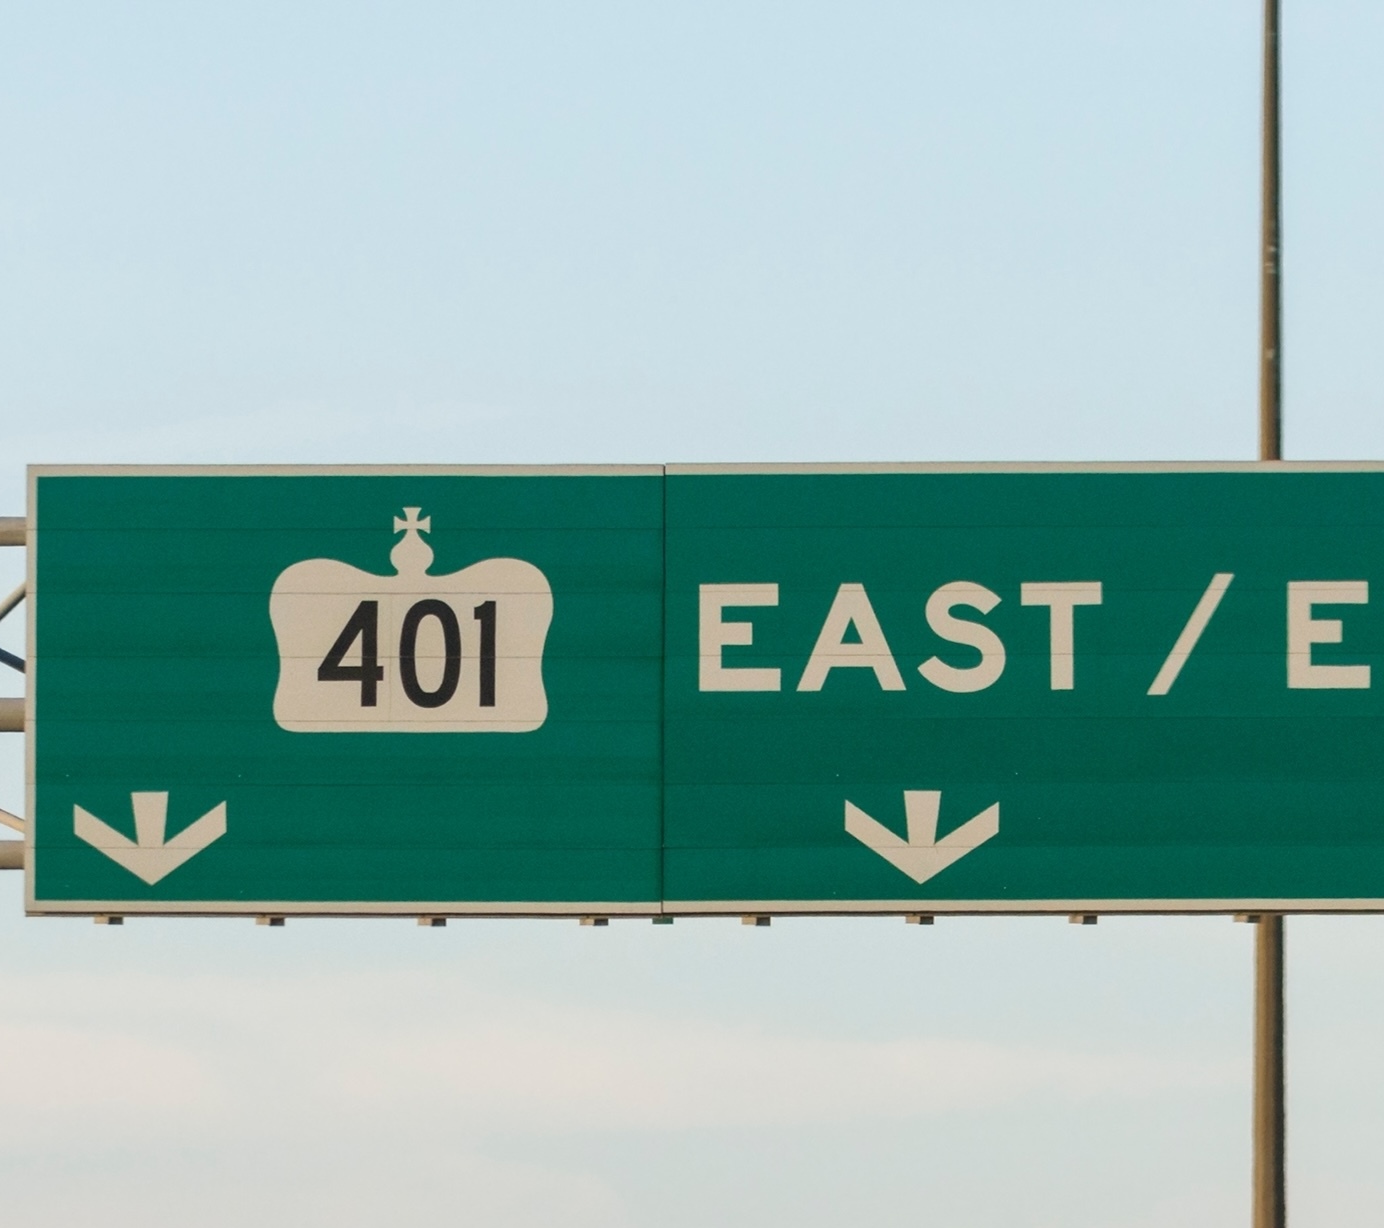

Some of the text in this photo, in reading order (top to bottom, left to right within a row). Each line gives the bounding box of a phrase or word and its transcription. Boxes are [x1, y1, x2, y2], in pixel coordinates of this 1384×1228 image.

[318, 598, 497, 708] 401
[699, 580, 1103, 693] EAST
[1147, 573, 1235, 696] /
